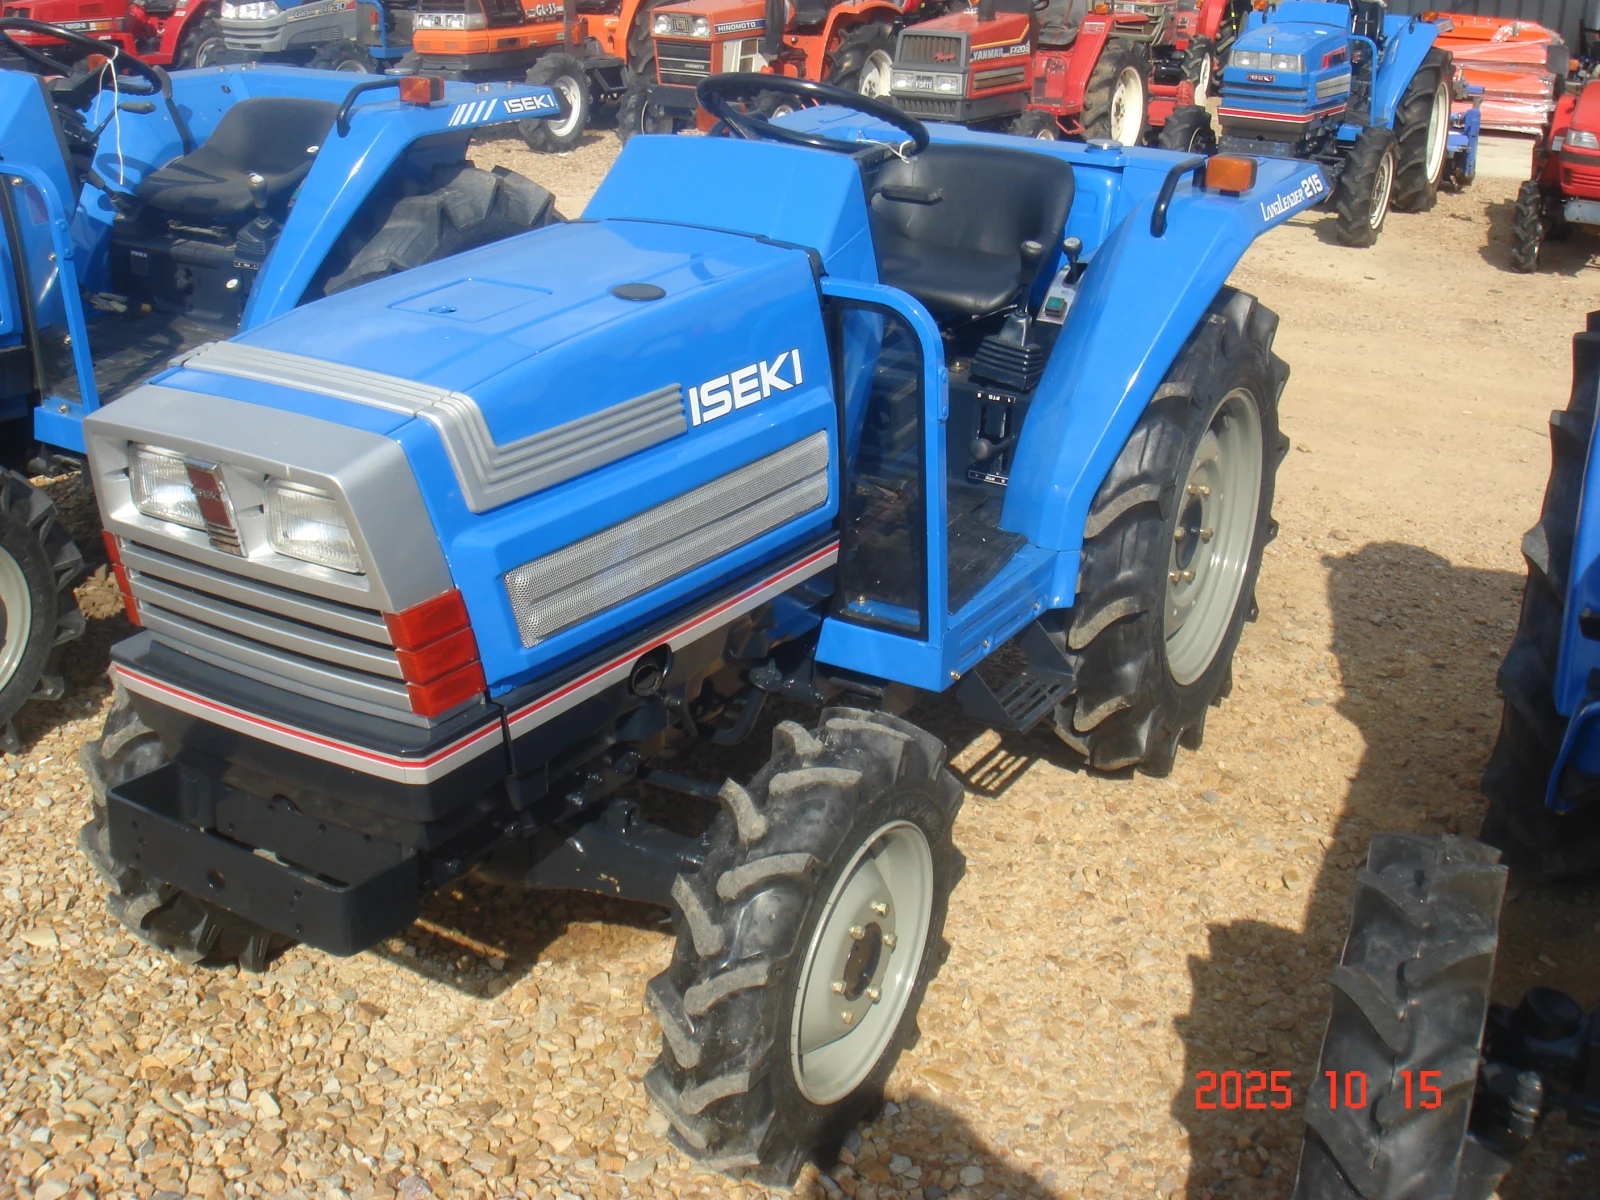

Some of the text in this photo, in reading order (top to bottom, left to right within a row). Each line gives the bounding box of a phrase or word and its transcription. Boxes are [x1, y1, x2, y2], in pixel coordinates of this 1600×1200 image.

[717, 21, 757, 32] HINOMOTO
[973, 48, 1004, 61] YANMAR
[503, 94, 555, 113] ISEKI
[1300, 173, 1324, 198] 215
[688, 348, 803, 427] ISEKI
